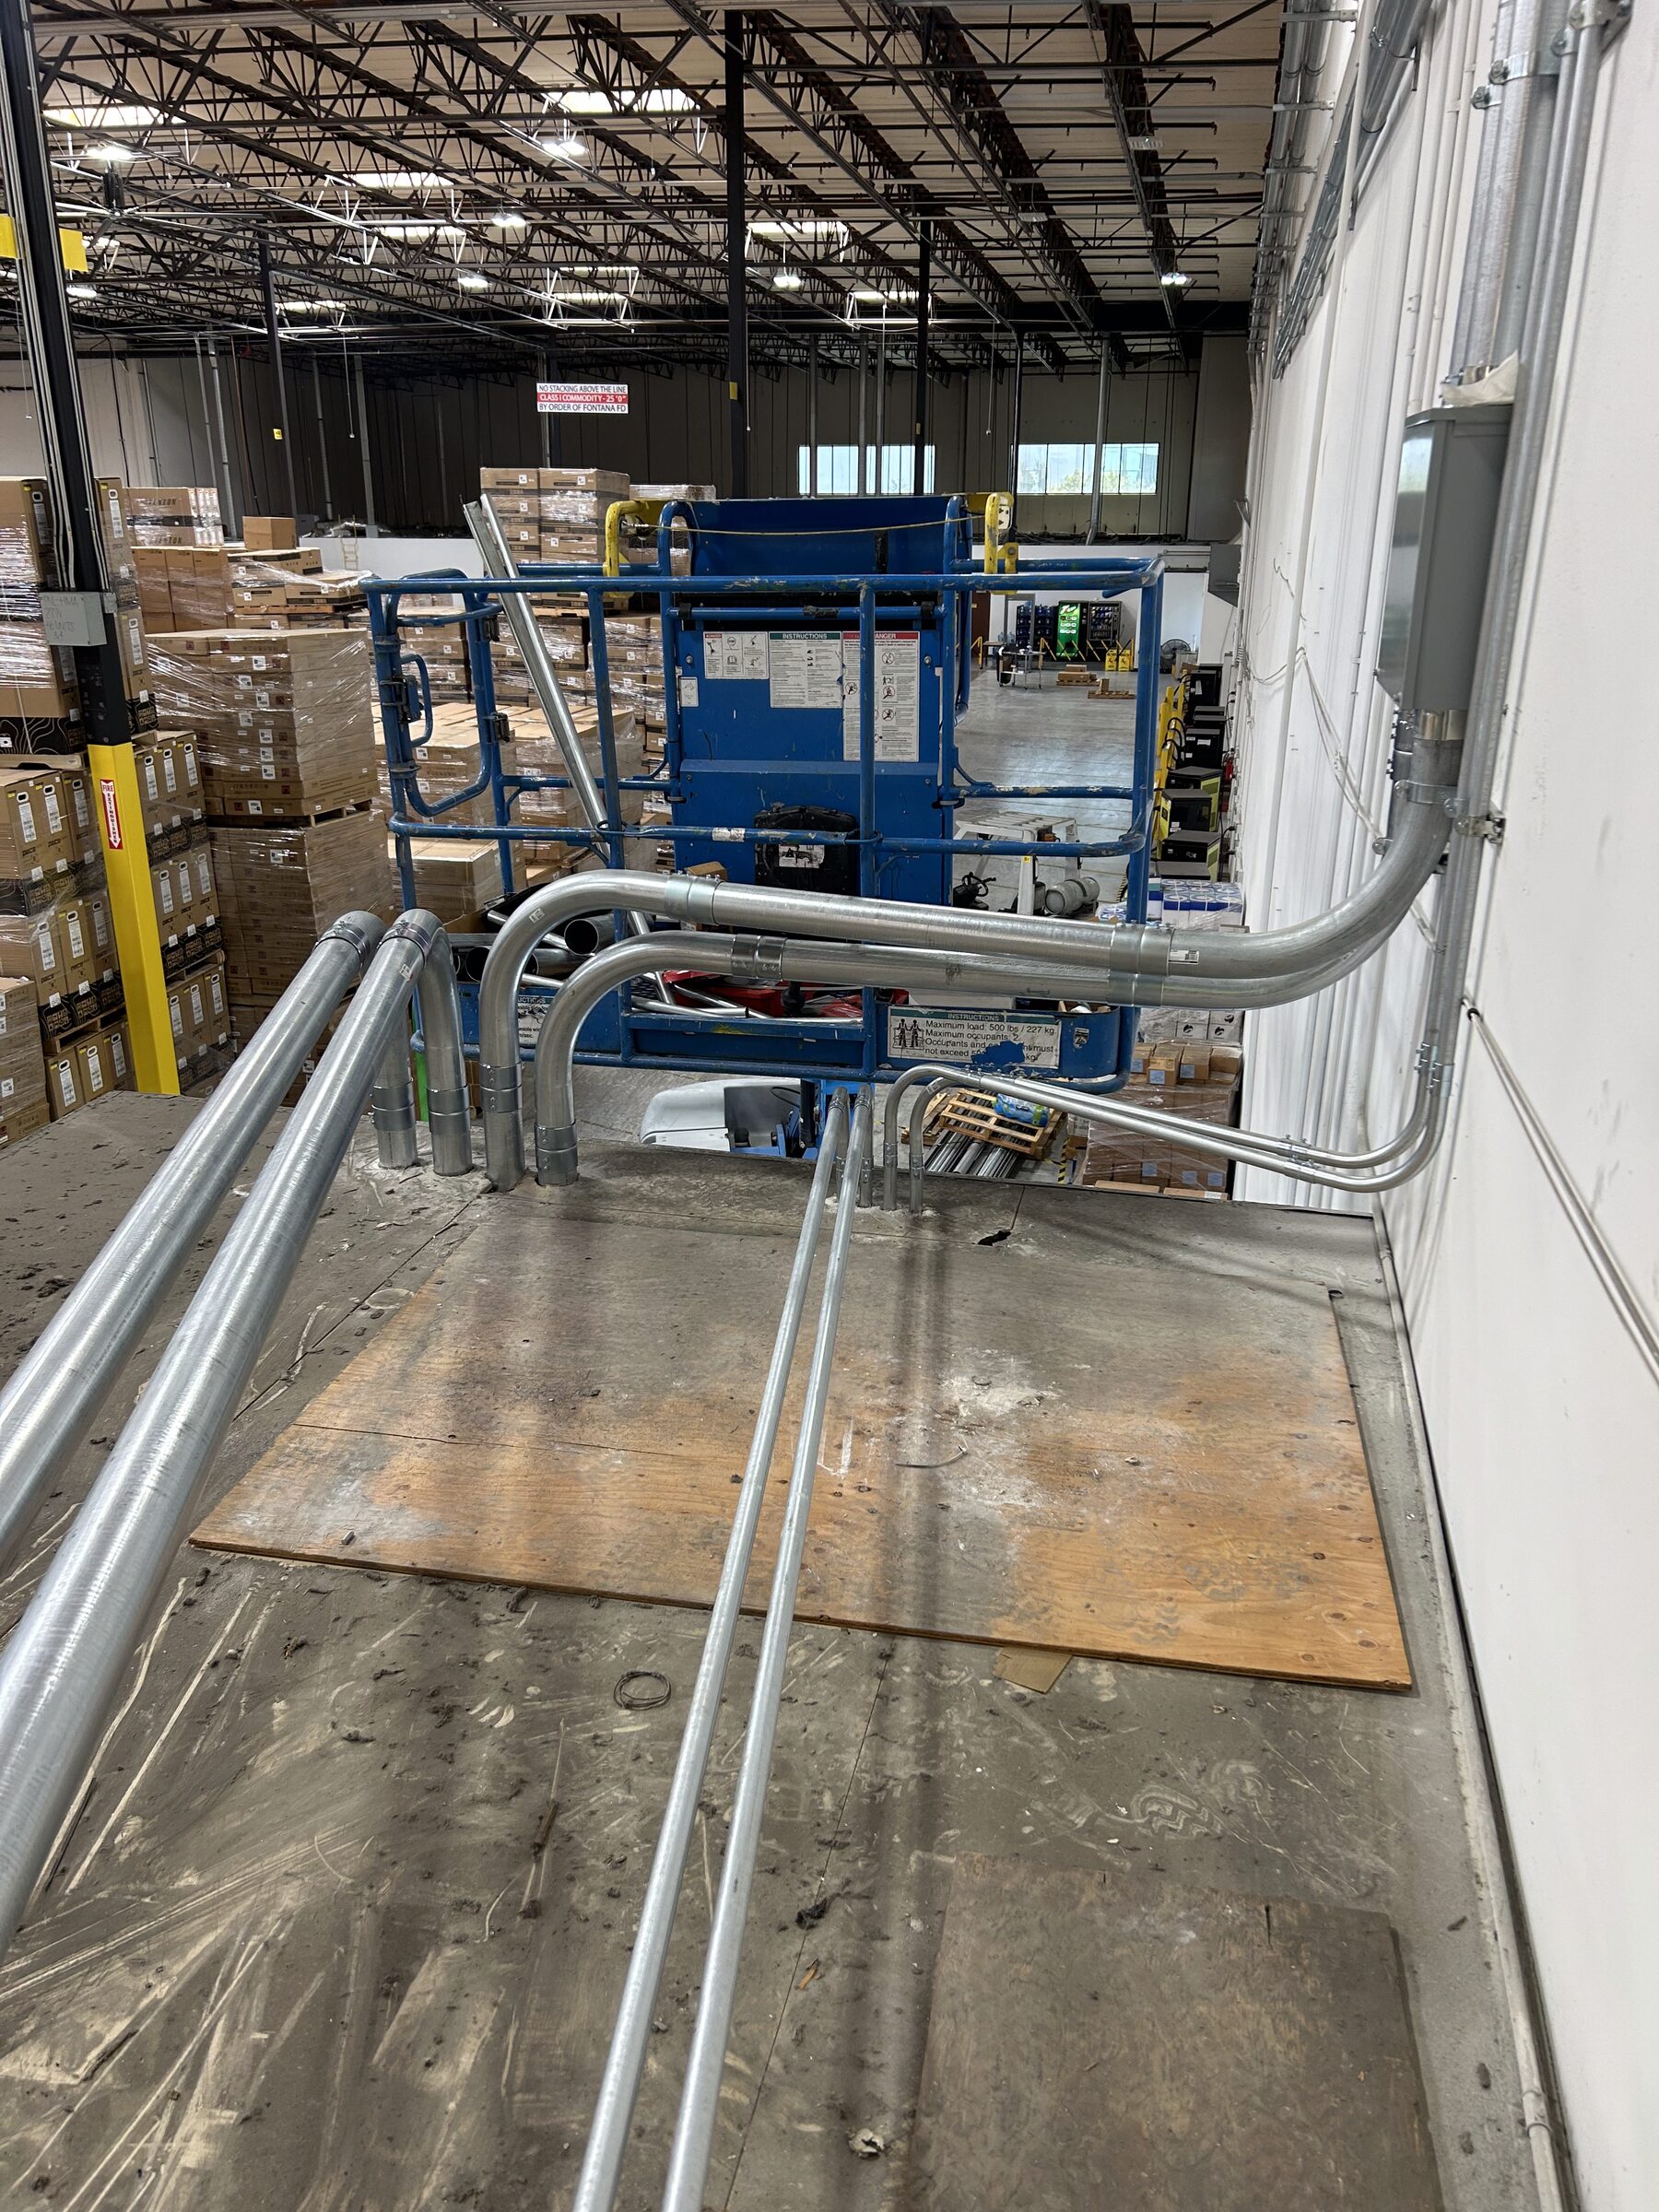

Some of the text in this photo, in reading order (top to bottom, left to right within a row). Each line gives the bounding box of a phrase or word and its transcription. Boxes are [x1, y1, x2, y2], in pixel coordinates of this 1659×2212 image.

[582, 404, 616, 412] FONTANA
[107, 793, 117, 843] EXTINGUISHER
[948, 1013, 1000, 1021] INSTRUCTIONS
[925, 1019, 965, 1030] Maximum
[989, 1023, 1006, 1031] 500
[1006, 1024, 1019, 1032] lbs
[925, 1029, 965, 1039] Maximum
[924, 1037, 969, 1048] Occupants
[939, 1049, 970, 1057] exceed
